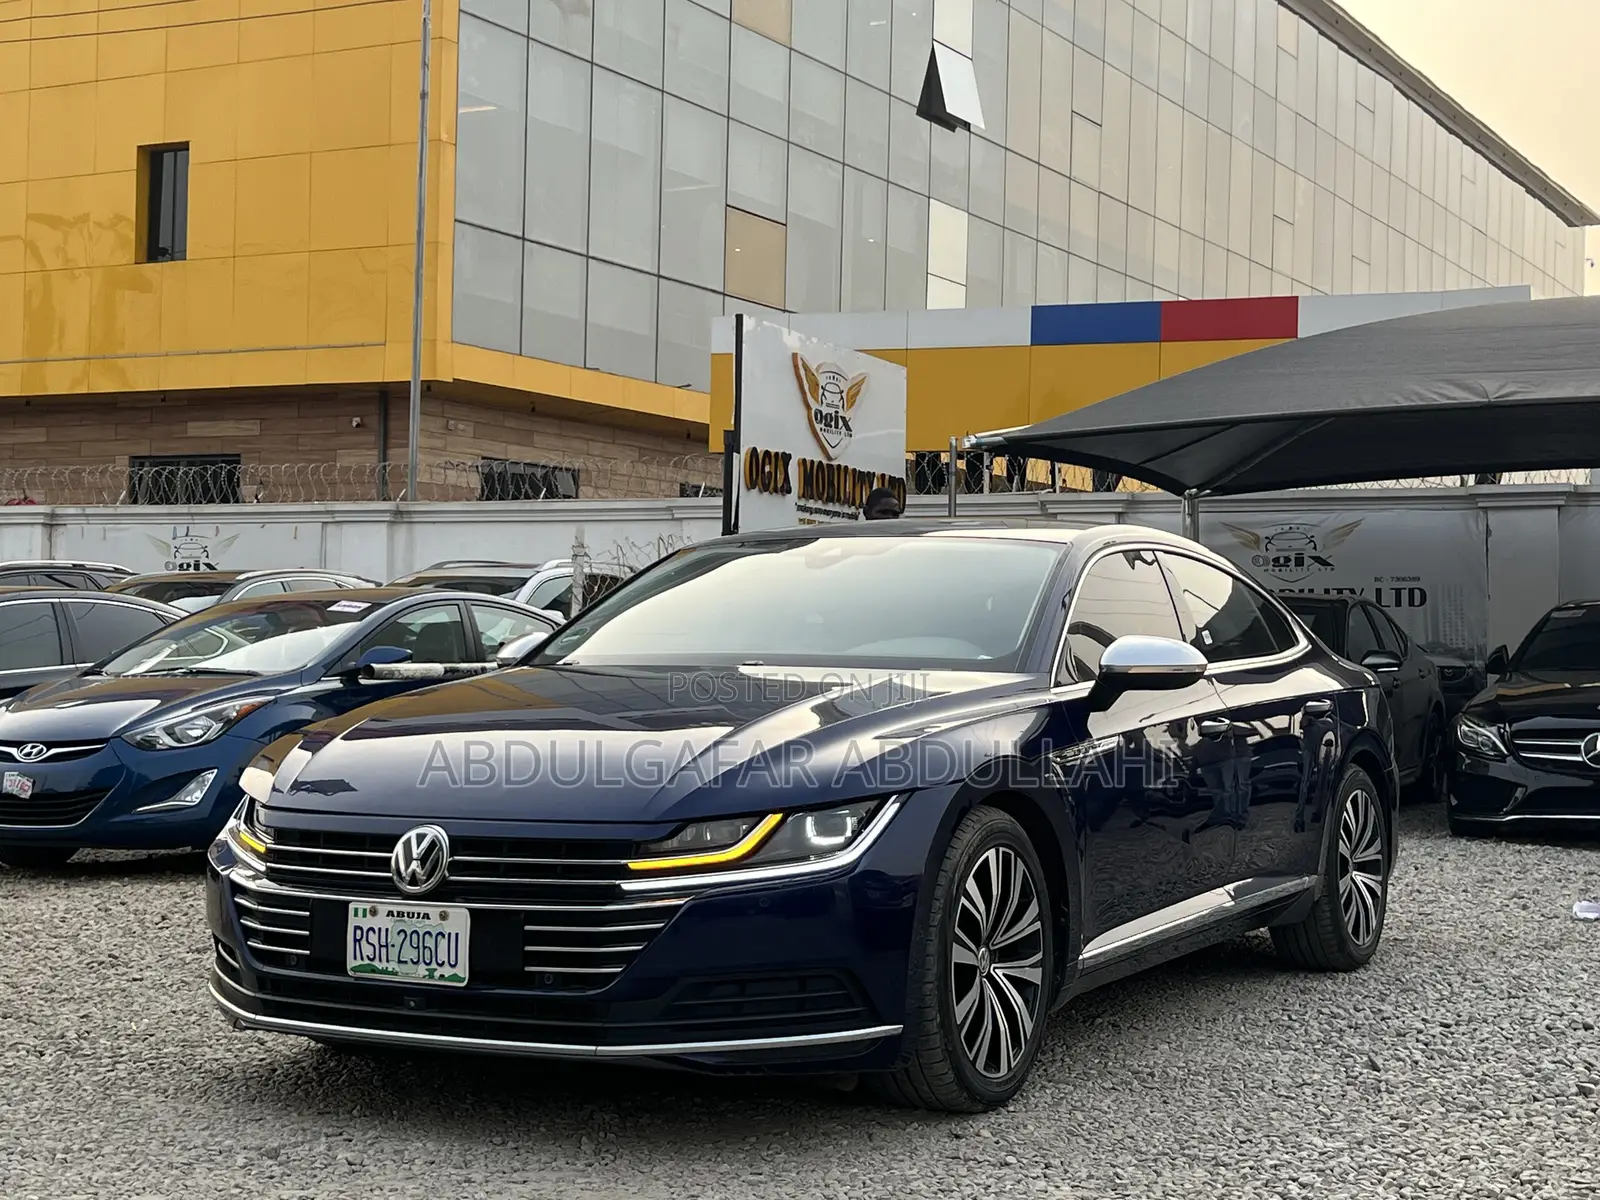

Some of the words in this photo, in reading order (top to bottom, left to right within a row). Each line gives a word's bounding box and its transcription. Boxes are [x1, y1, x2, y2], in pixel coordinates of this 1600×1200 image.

[744, 446, 792, 496] OGIX
[797, 457, 876, 511] MOBILITY
[1375, 587, 1427, 607] LTD
[385, 909, 431, 921] ABUJA
[352, 924, 460, 969] RSH-296CU
